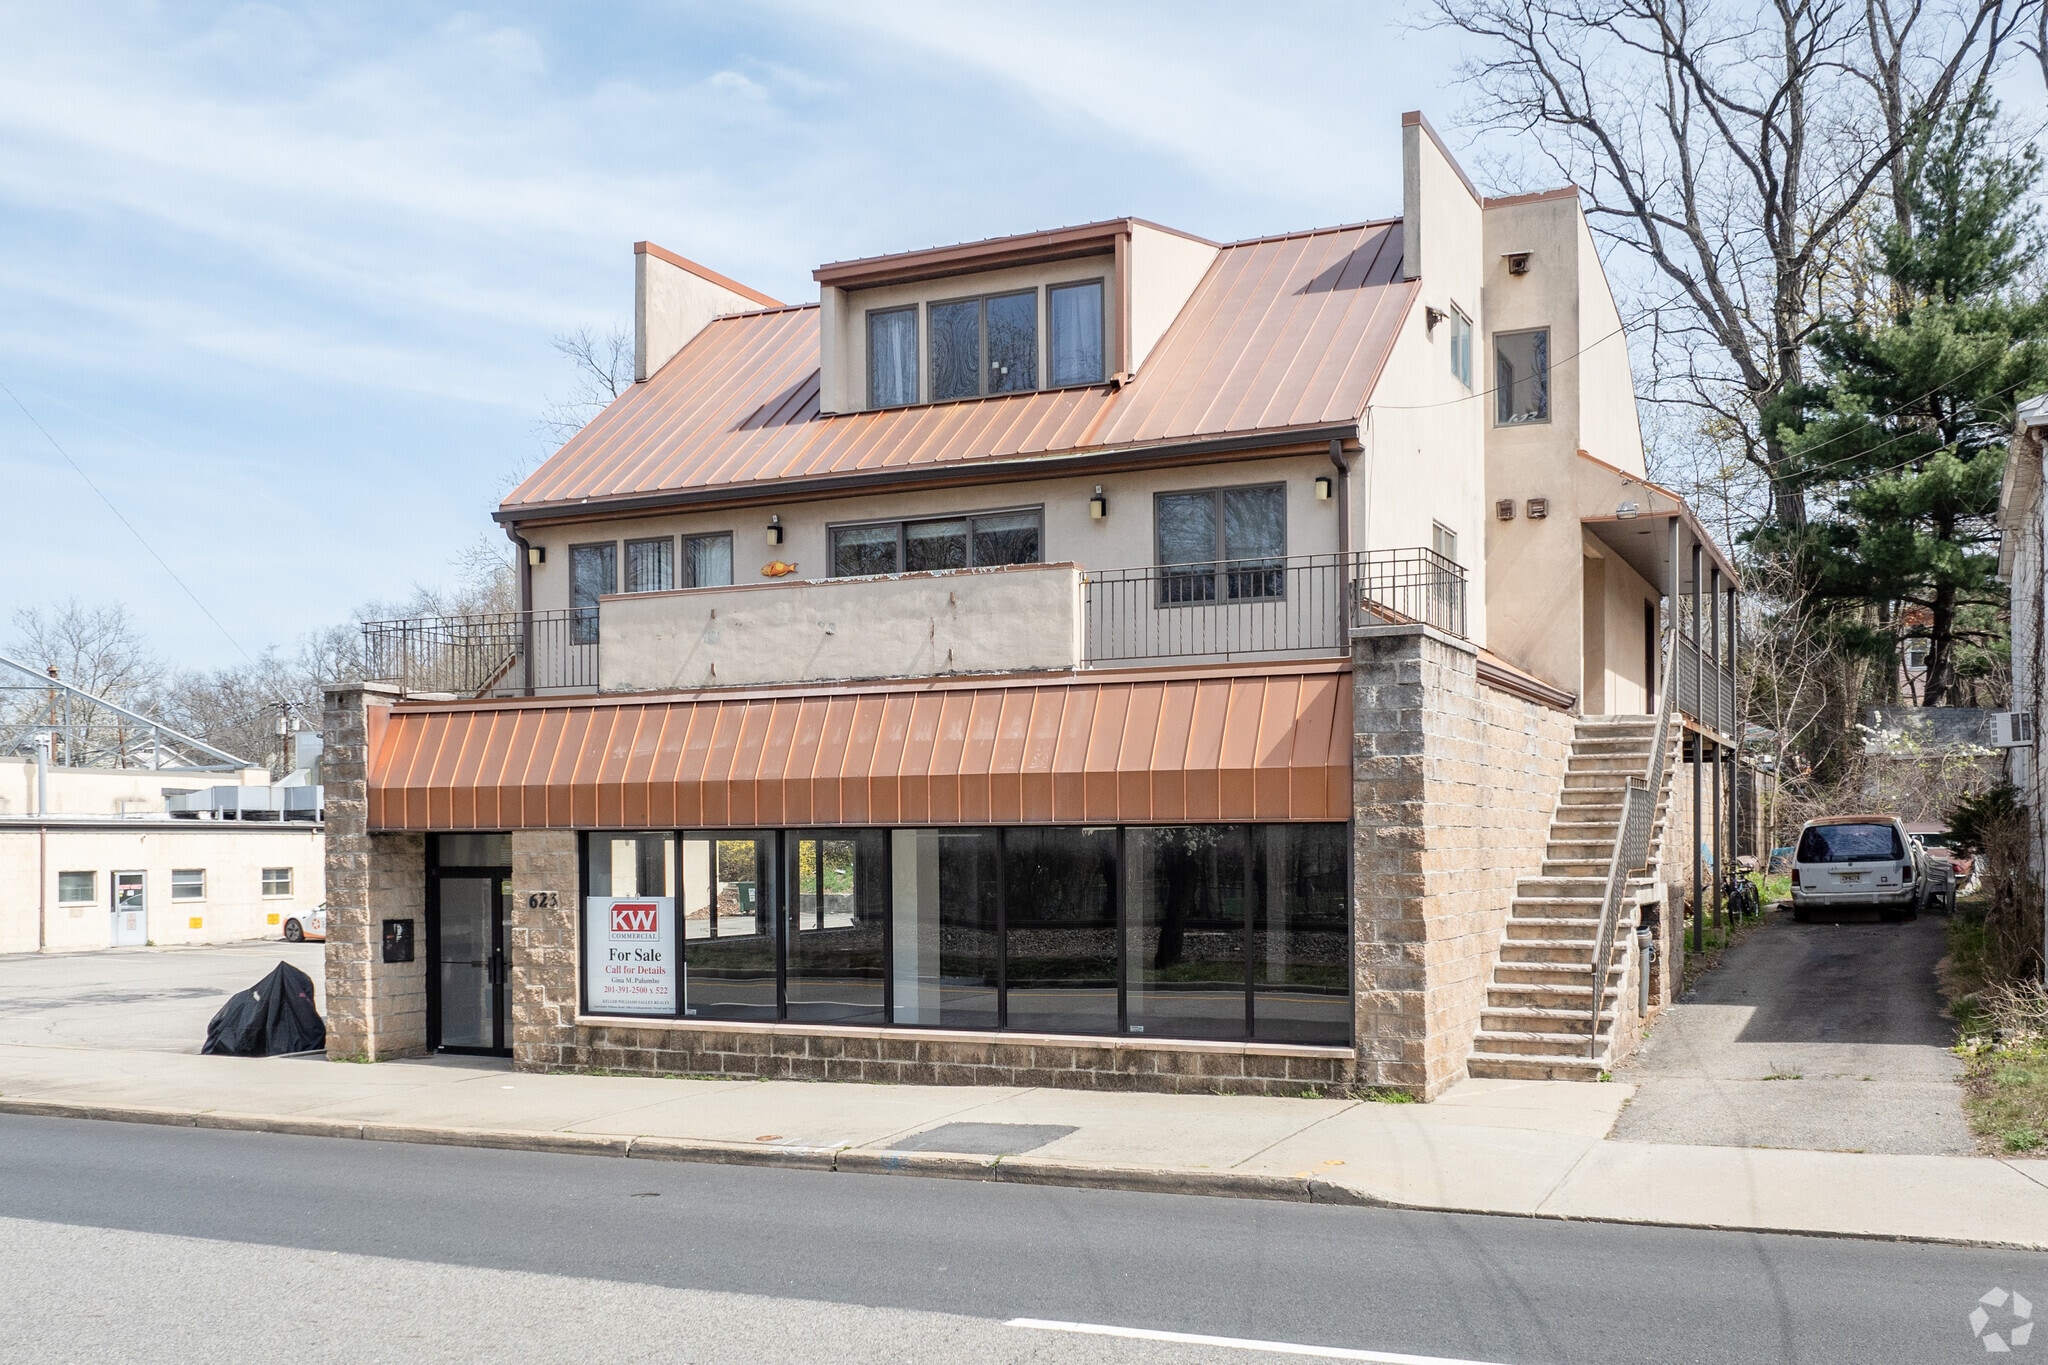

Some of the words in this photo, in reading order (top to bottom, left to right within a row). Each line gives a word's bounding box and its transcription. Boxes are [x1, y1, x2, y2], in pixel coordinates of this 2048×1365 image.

[529, 892, 558, 909] 623
[611, 910, 657, 931] KW
[609, 948, 631, 961] For
[634, 948, 662, 962] Sale
[605, 965, 622, 974] Call
[623, 965, 636, 974] for
[637, 966, 666, 975] Details
[604, 986, 648, 994] 201-391-2500
[655, 987, 668, 995] 522
